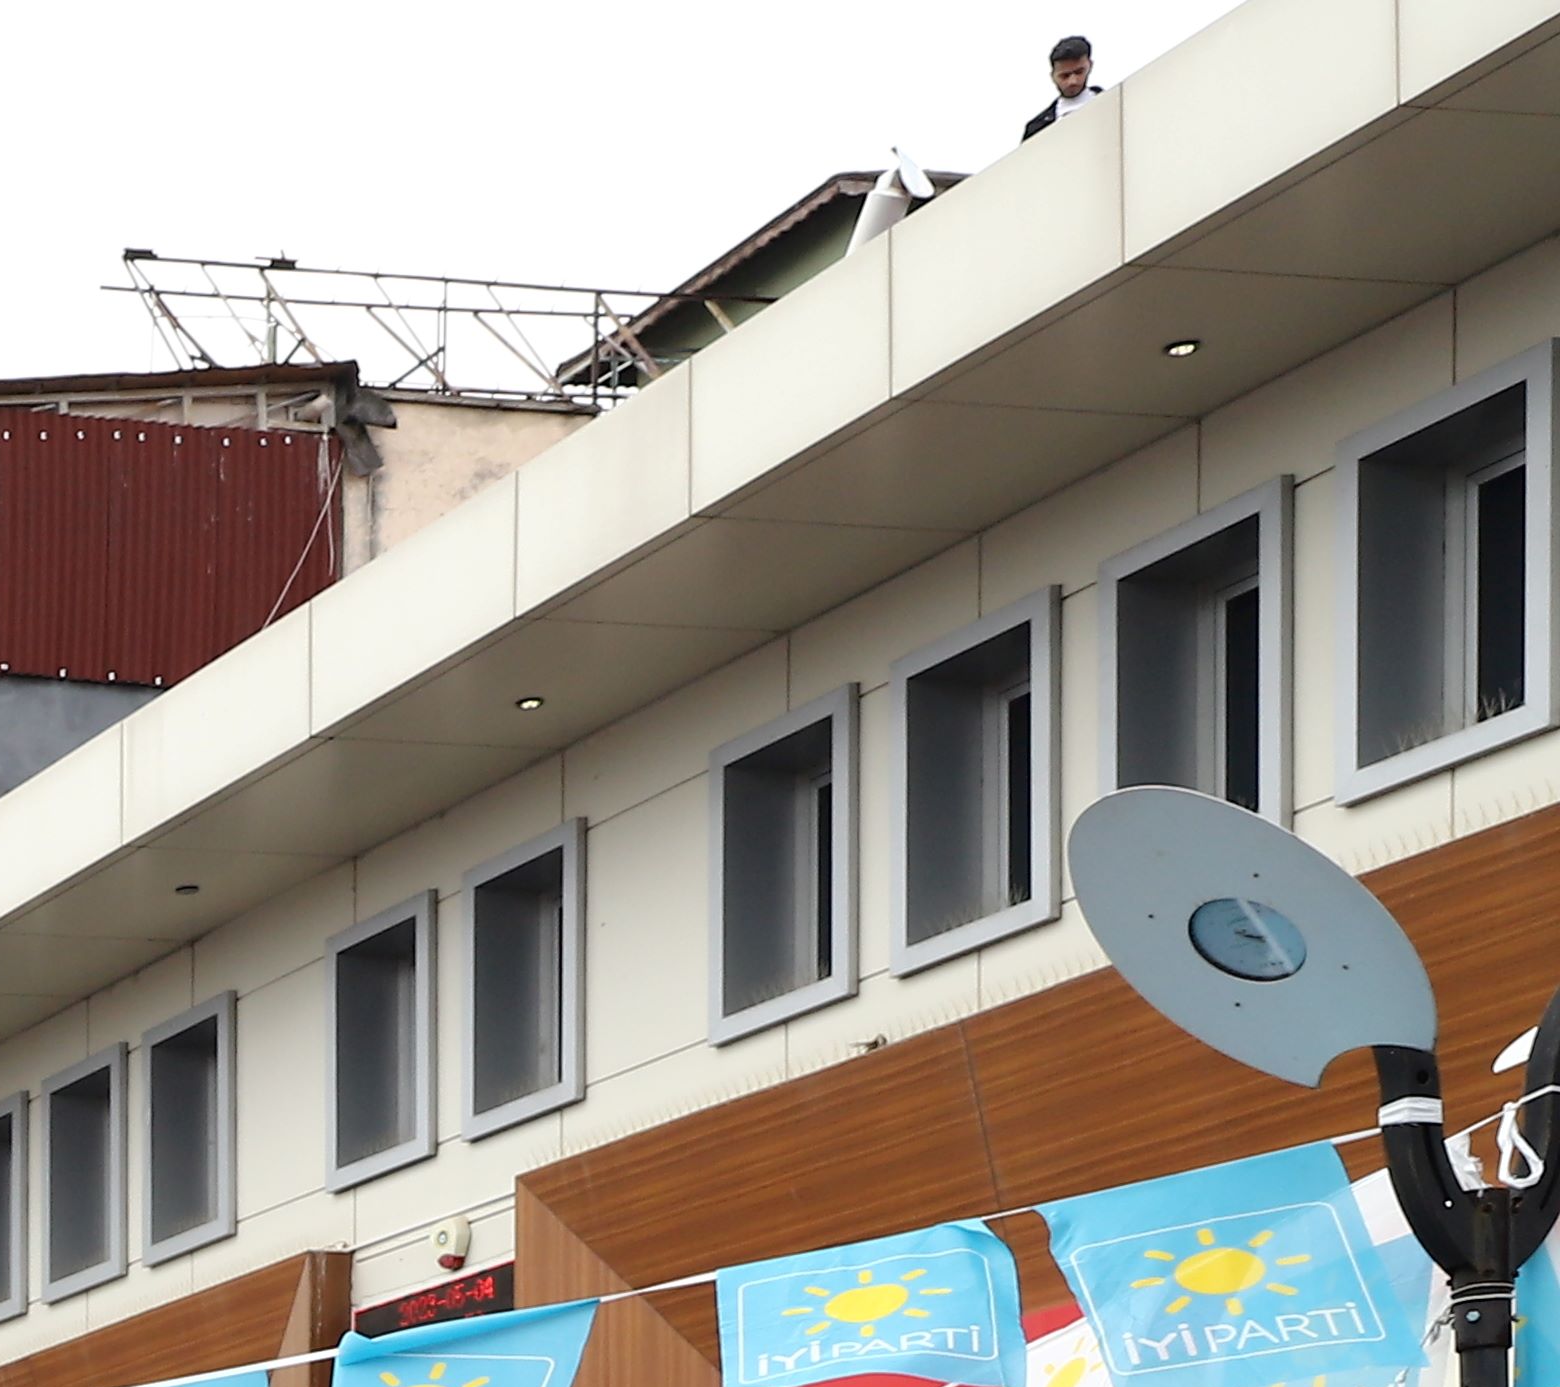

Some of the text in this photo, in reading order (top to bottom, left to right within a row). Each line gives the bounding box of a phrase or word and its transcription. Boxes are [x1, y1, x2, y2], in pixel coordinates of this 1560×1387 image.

[757, 1325, 981, 1378] İYİ PARTİ
[1122, 1302, 1366, 1365] İYİ PARTİ
